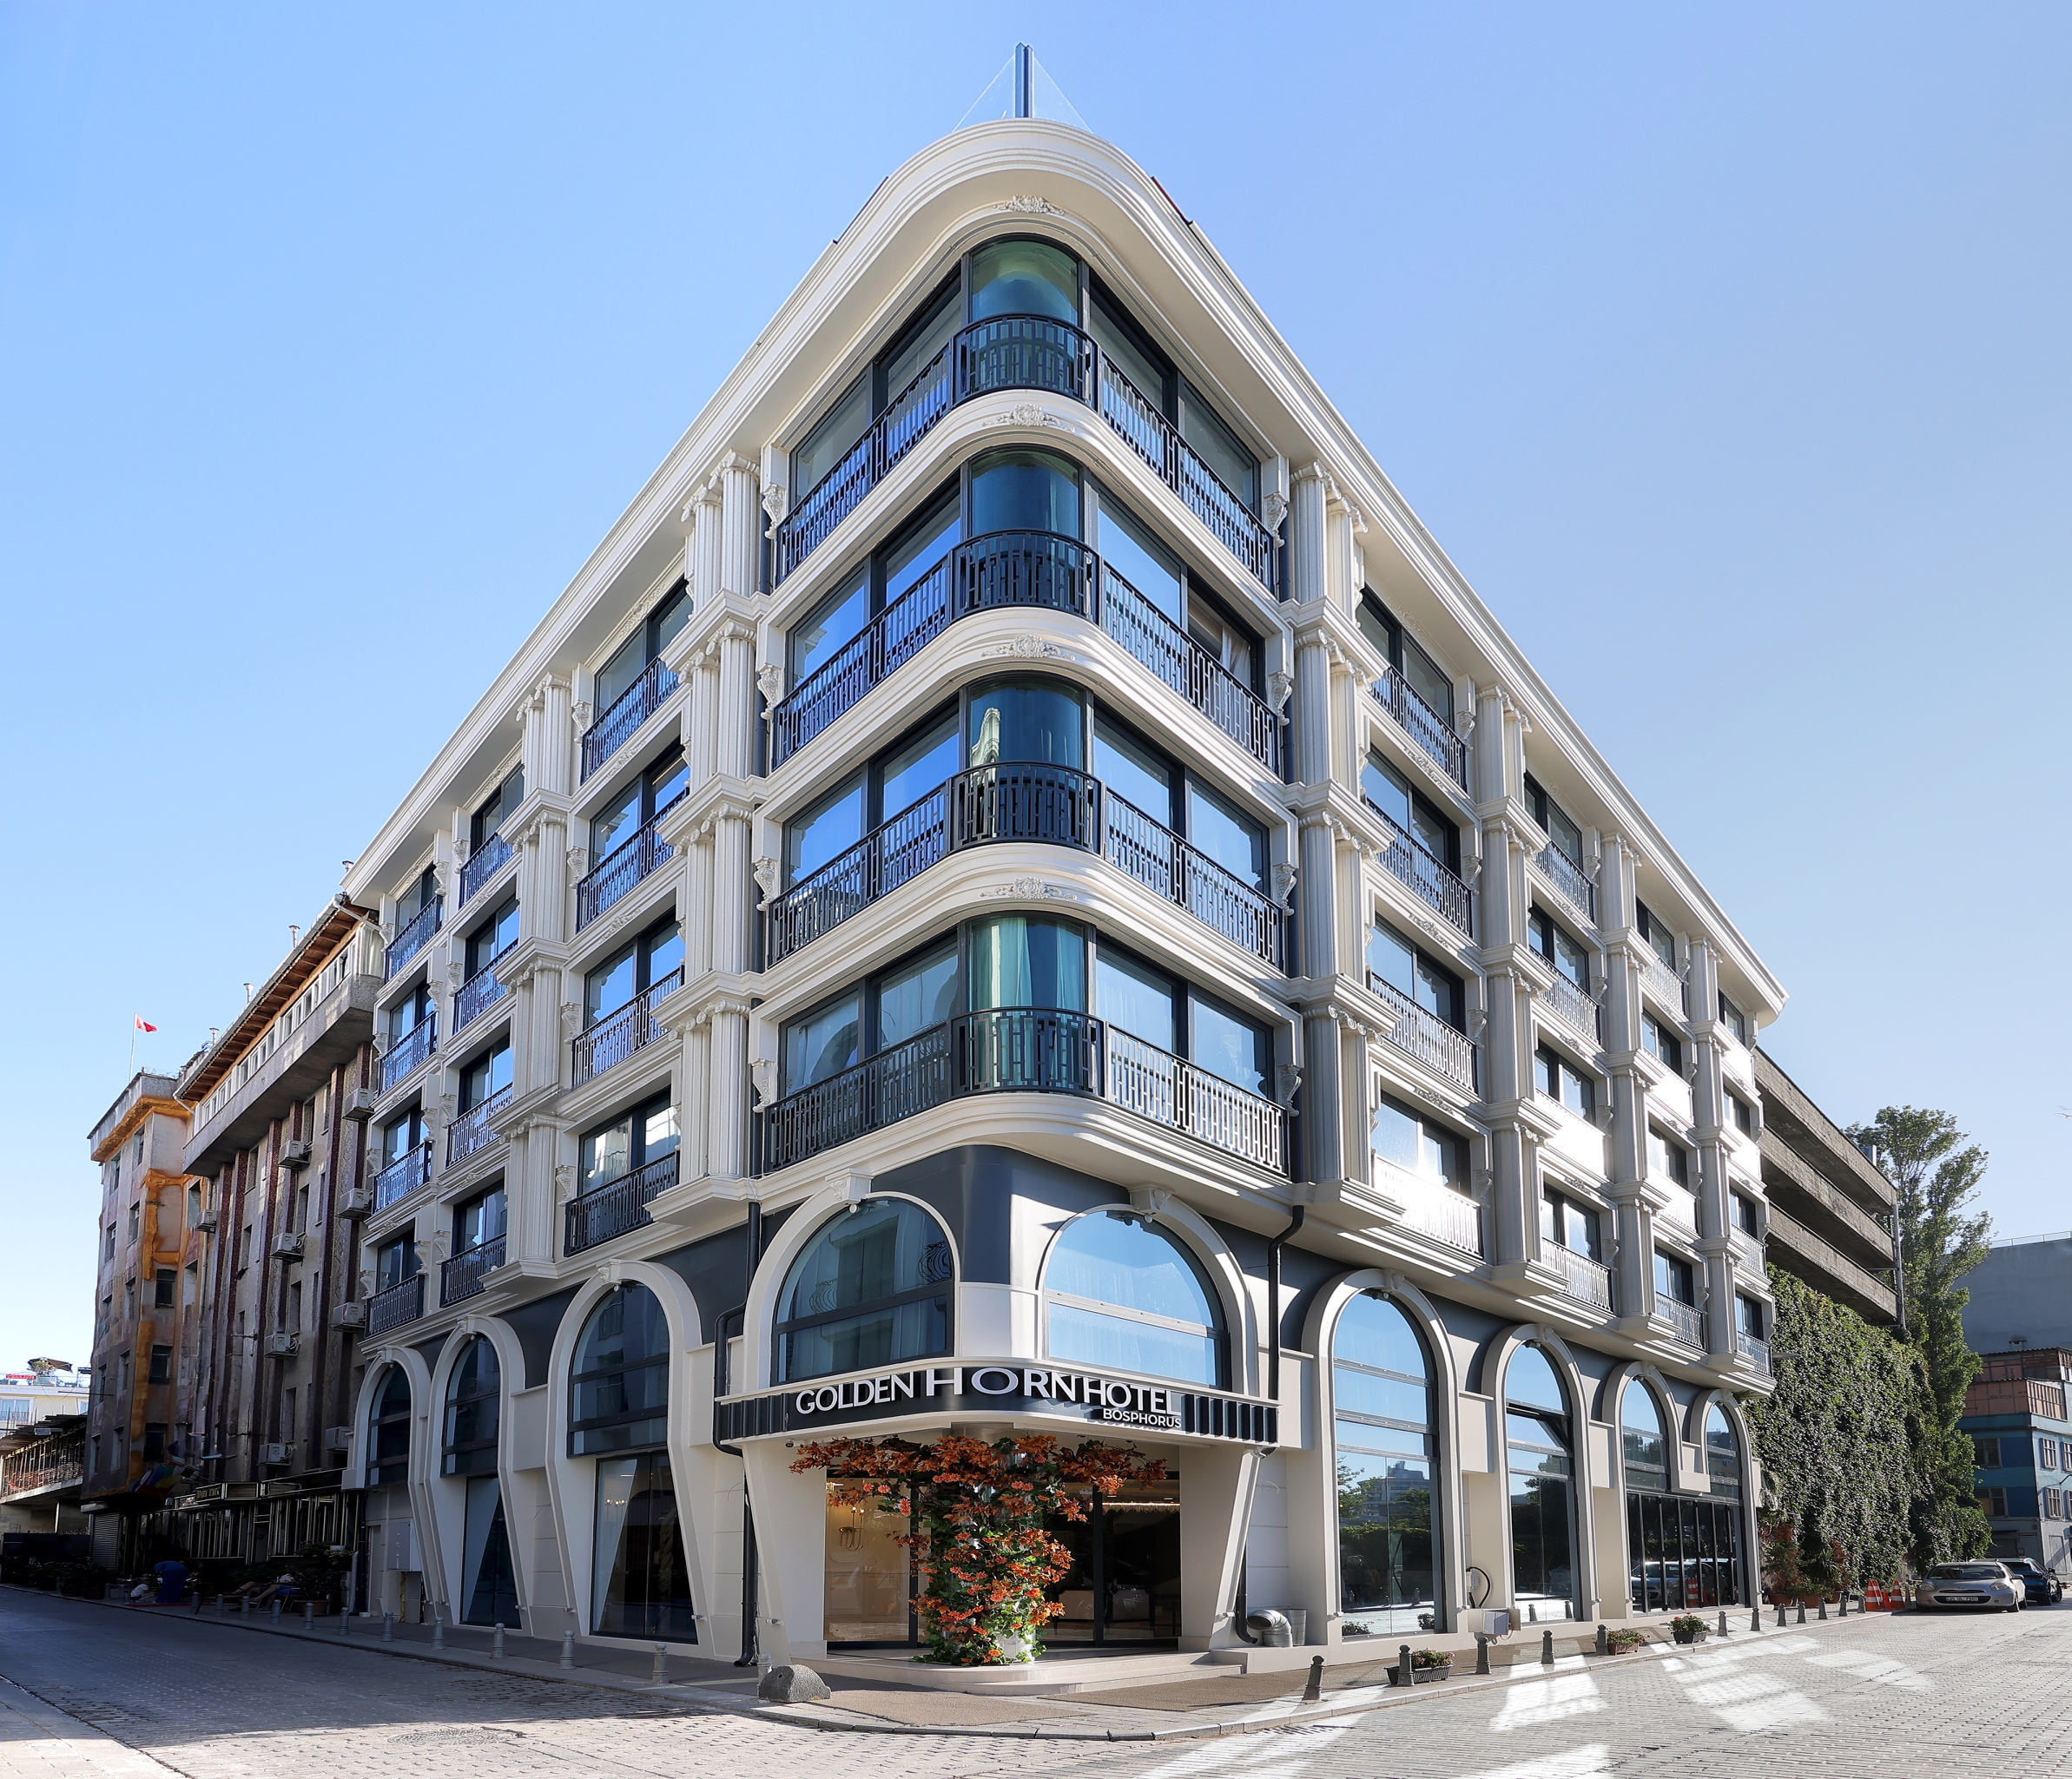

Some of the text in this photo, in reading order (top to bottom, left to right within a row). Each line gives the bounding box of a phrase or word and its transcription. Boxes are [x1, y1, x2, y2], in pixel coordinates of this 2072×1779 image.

[795, 1367, 1182, 1416] GOLDEN HORN HOTEL
[1103, 1407, 1182, 1428] BOSPHORUS
